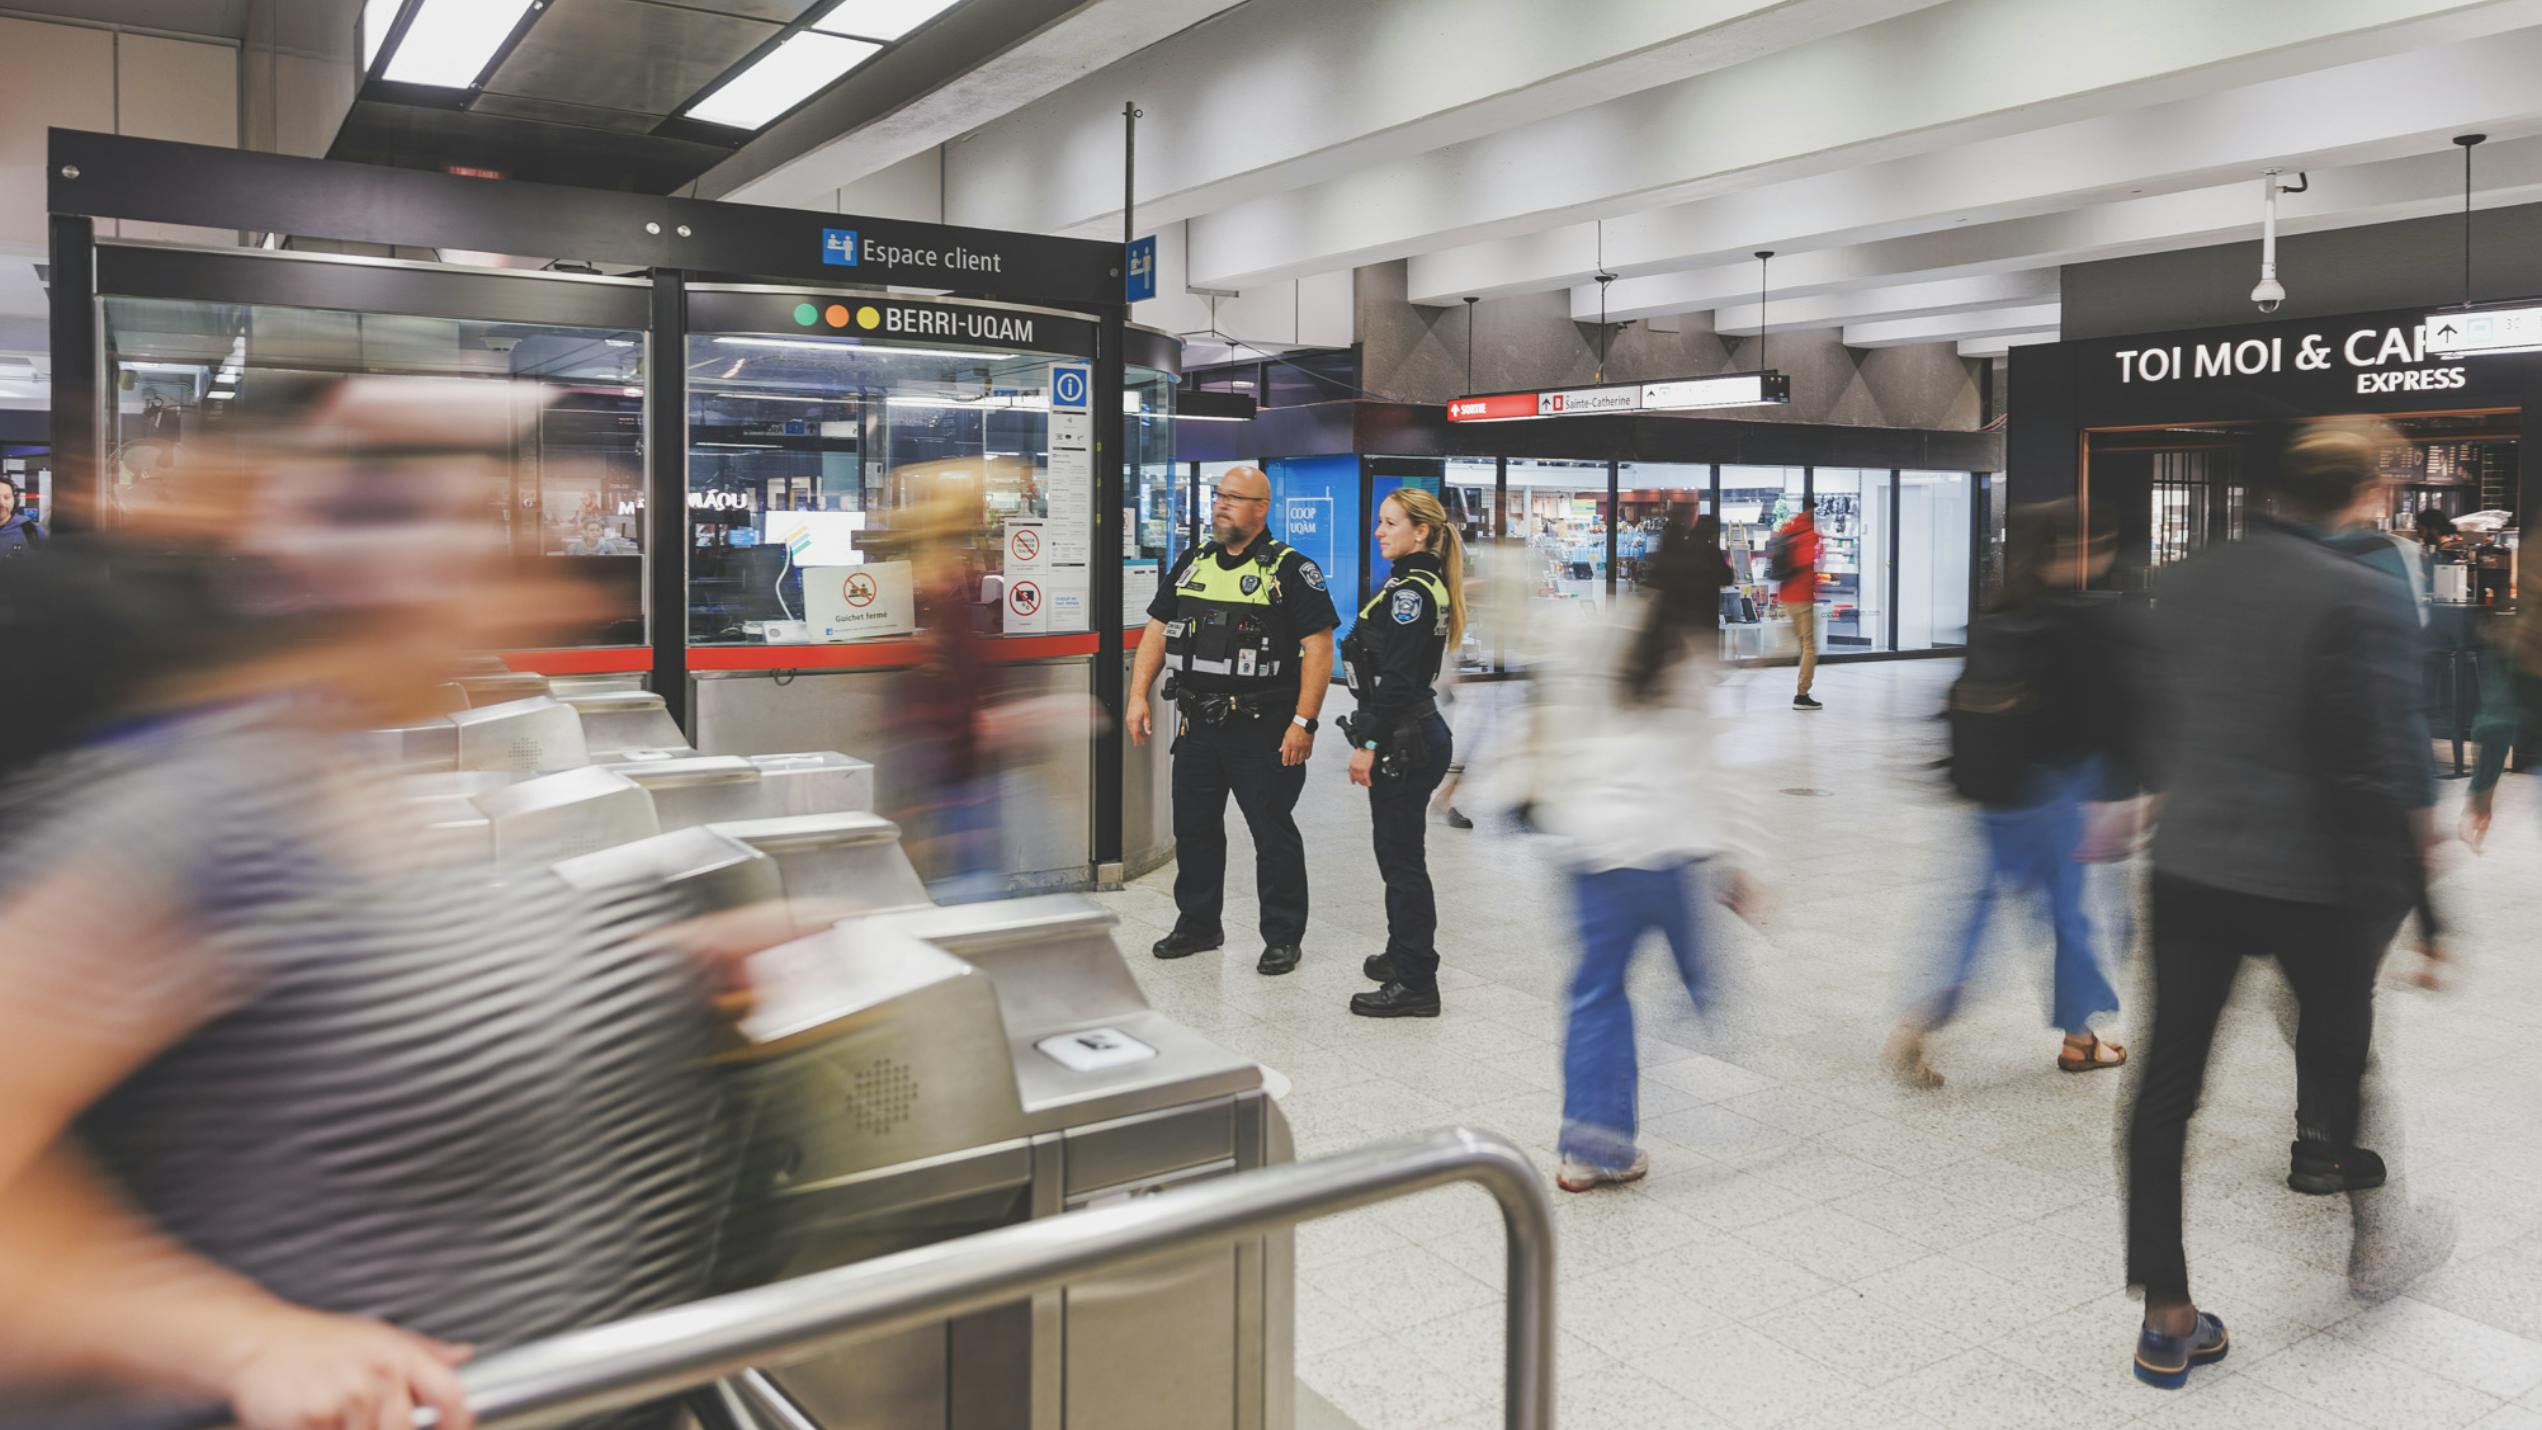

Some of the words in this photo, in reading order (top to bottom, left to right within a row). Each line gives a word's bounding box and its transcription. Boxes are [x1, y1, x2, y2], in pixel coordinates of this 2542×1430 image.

[863, 239, 937, 268] Espace
[944, 247, 1002, 272] client
[886, 307, 1033, 342] BERRI-UQAM
[2115, 347, 2181, 383] TOI
[2194, 338, 2282, 378] MOI
[2295, 334, 2331, 370] &
[2343, 326, 2465, 367] CAF
[2357, 366, 2466, 394] EXPRESS
[1461, 402, 1487, 415] SORTIE
[1565, 396, 1631, 410] Sainte-Catherine
[1290, 507, 1317, 520] COOP
